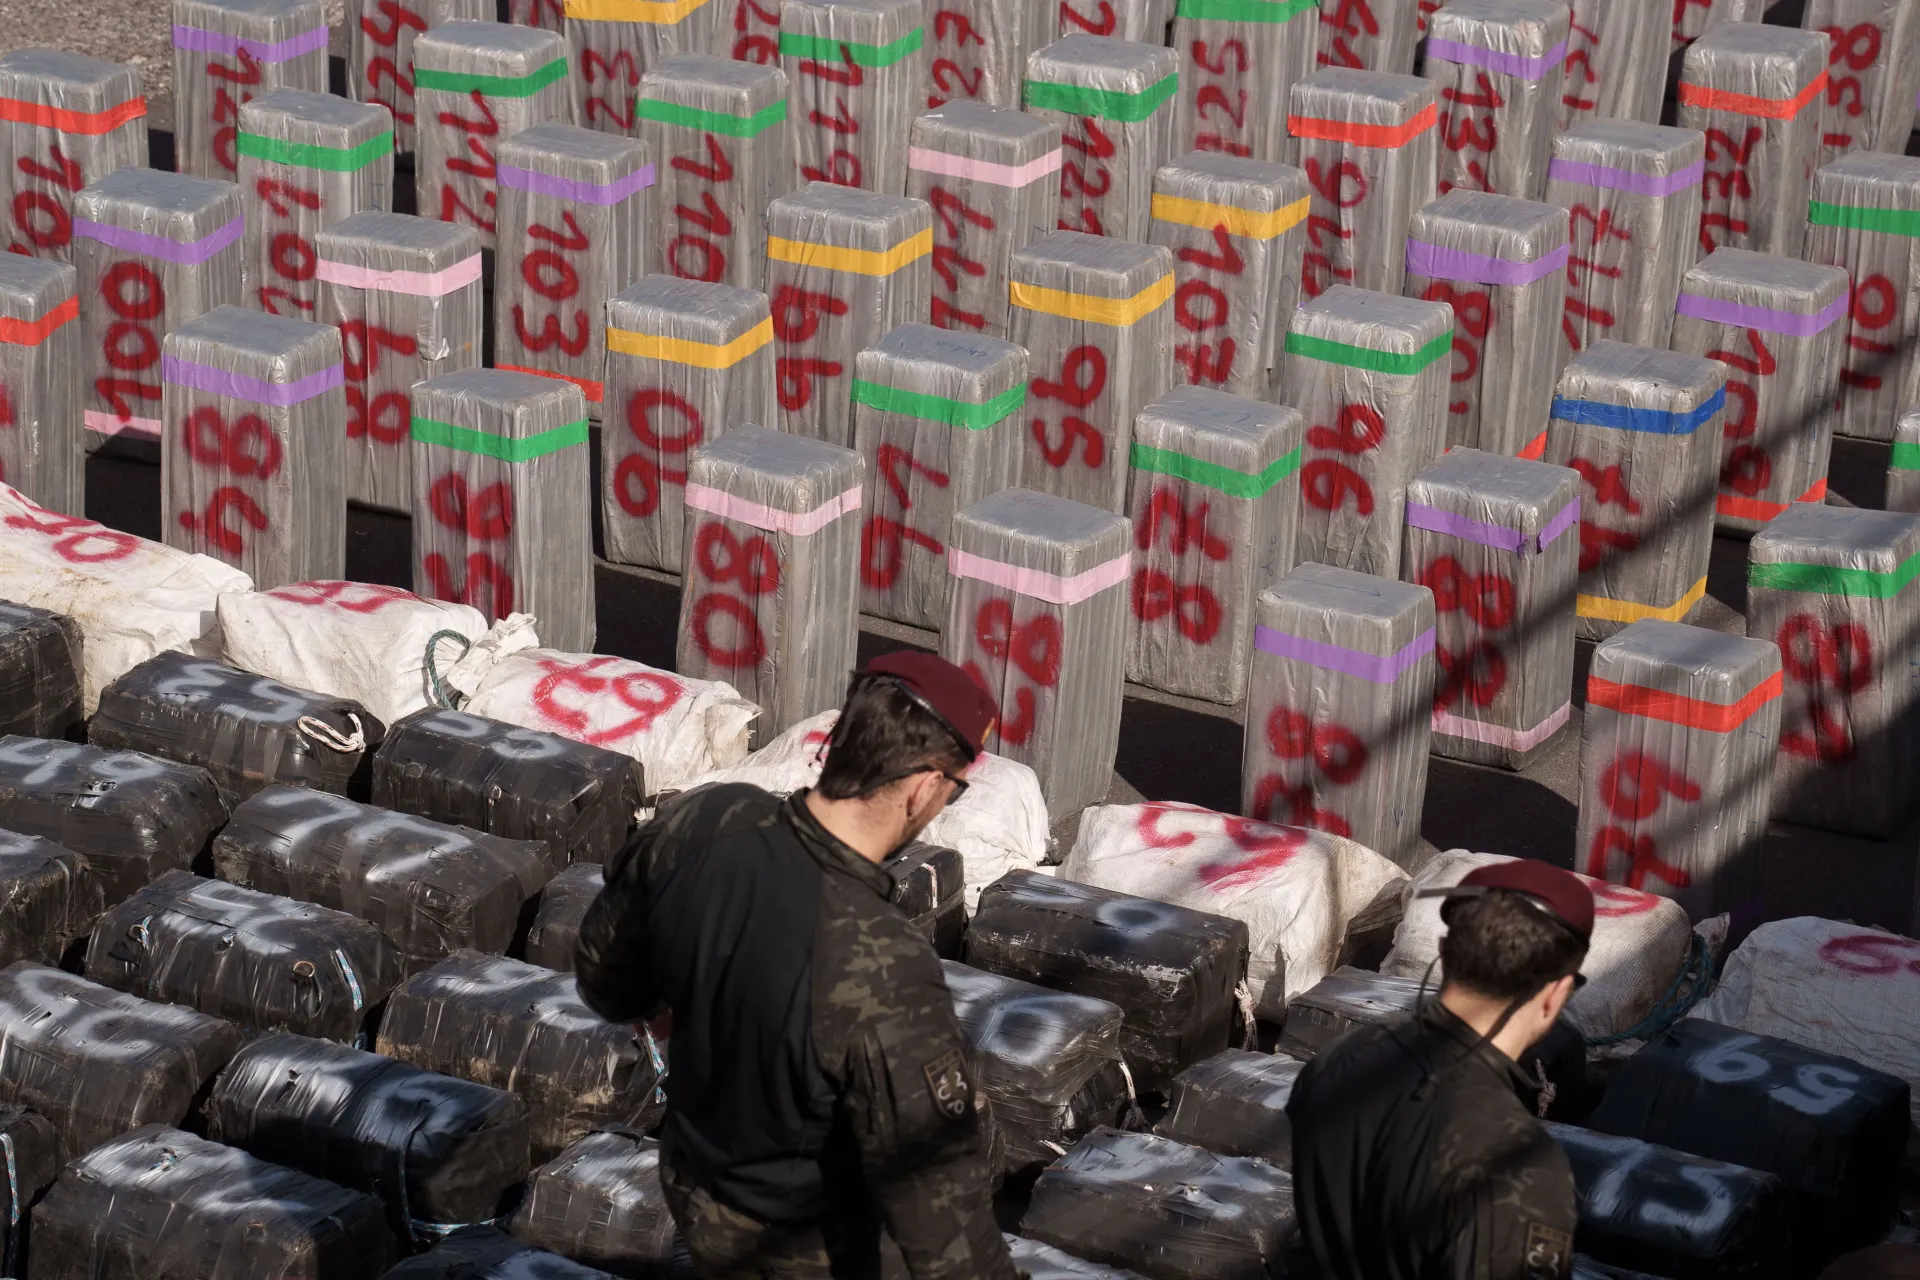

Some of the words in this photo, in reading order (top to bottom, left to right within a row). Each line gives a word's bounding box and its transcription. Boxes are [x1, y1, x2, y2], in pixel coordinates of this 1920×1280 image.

[1192, 37, 1252, 160] 125
[8, 144, 86, 258] 10
[256, 177, 326, 316] 101
[669, 134, 735, 285] 110
[932, 186, 996, 334] 111
[1302, 154, 1368, 298] 116
[1701, 131, 1764, 248] 132
[94, 262, 166, 422] 100
[514, 209, 592, 369] 103
[1175, 222, 1245, 388] 107
[1428, 281, 1498, 414] 08
[1567, 201, 1632, 351] 117
[178, 404, 286, 562] 84
[612, 386, 706, 520] 90
[860, 442, 950, 592] 91
[1303, 402, 1386, 520] 96
[688, 522, 782, 672] 80
[1131, 486, 1229, 647] 87
